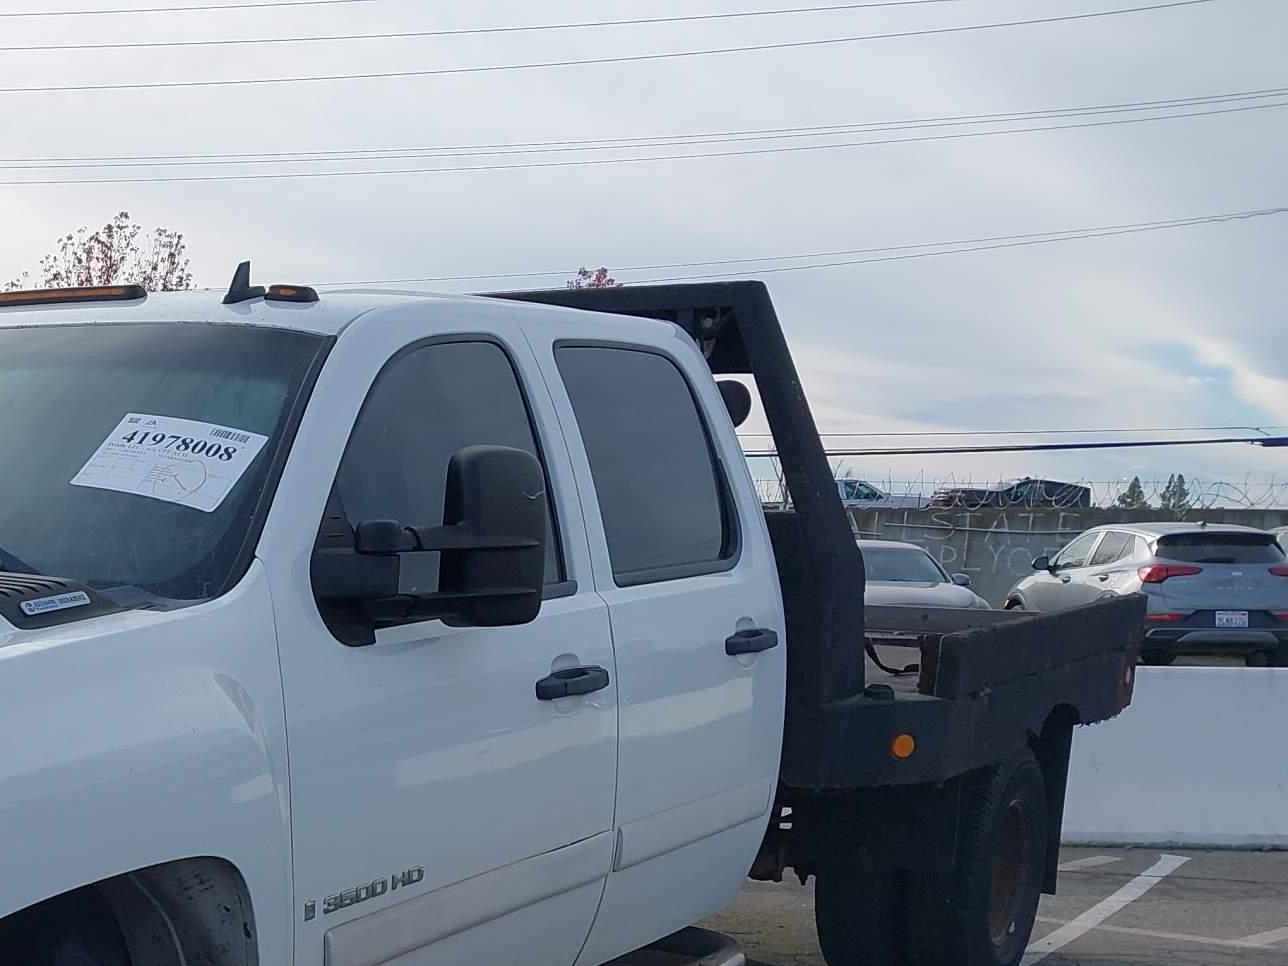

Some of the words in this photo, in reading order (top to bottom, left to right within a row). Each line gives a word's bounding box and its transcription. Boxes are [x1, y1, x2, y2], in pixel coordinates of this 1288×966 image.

[121, 429, 238, 463] 41978008
[323, 876, 388, 915] 3500
[391, 864, 425, 891] HD
